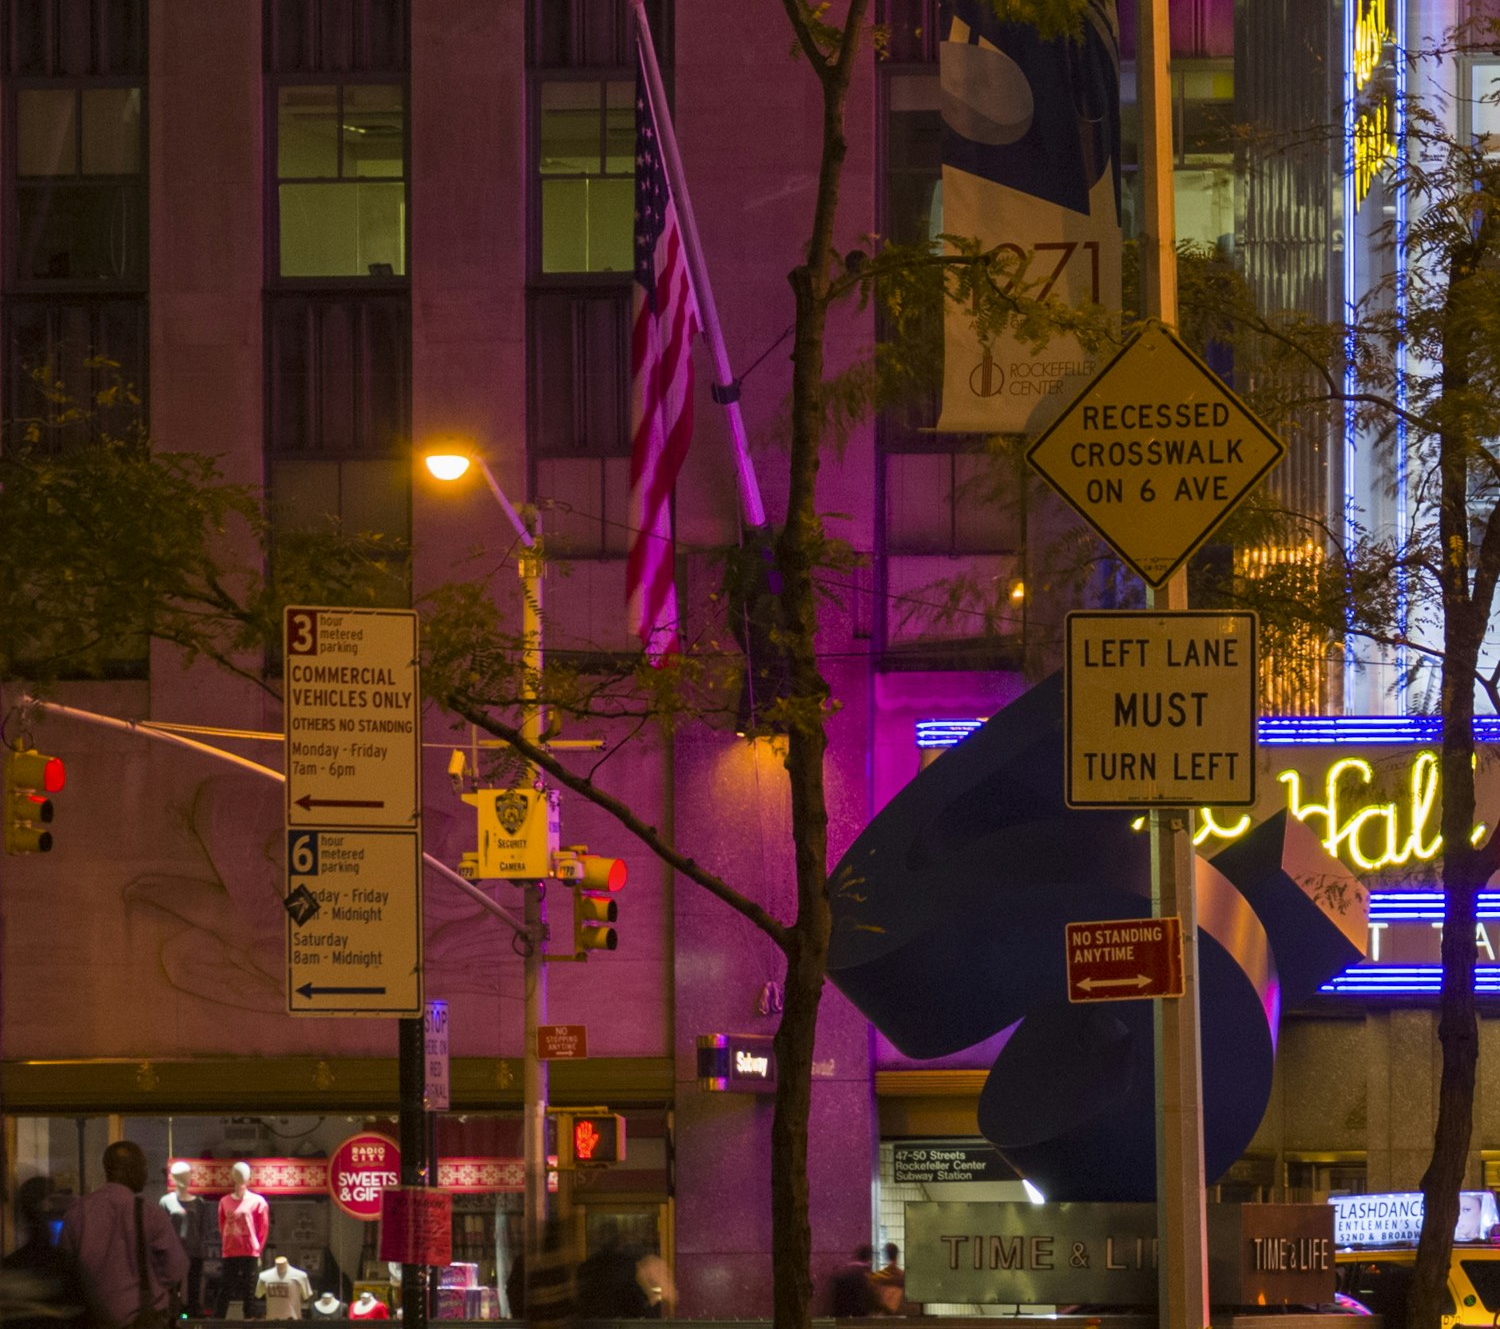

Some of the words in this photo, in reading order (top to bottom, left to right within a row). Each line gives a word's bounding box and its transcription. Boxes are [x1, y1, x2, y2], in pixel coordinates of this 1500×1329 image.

[1010, 361, 1096, 378] ROCKEFELLER
[1009, 381, 1063, 395] CENTER
[1083, 403, 1229, 430] RECESSED
[1071, 439, 1243, 467] CROSSWALK
[1087, 479, 1122, 503] ON
[1140, 479, 1155, 502] 6
[1174, 476, 1228, 501] AVE
[320, 615, 343, 627] hour
[292, 614, 312, 653] 3
[320, 628, 363, 641] metered
[320, 642, 358, 655] parking
[1085, 639, 1149, 667] LEFT
[1168, 639, 1238, 667] LANE
[292, 665, 396, 686] COMMERCIAL
[293, 689, 367, 708] VEHICLES
[372, 691, 412, 709] ONLY
[1115, 693, 1208, 726] MUST
[292, 717, 335, 732] OTHERS
[339, 718, 354, 732] NO
[358, 719, 413, 733] STANDING
[292, 742, 339, 759] Monday
[351, 744, 387, 760] Friday
[293, 761, 317, 776] 7am
[329, 763, 355, 778] 6pm
[1084, 753, 1155, 780] TURN
[1174, 753, 1239, 780] LEFT
[1278, 749, 1488, 869] Hal
[321, 835, 344, 846] hour
[292, 835, 313, 873] 6
[321, 849, 364, 860] metered
[321, 862, 360, 875] parking
[352, 889, 388, 905] Friday
[333, 907, 382, 925] Midnight
[294, 932, 348, 949] Saturday
[1072, 931, 1091, 946] NO
[1096, 927, 1162, 945] STANDING
[294, 952, 320, 964] 8am
[333, 951, 382, 968] Midnight
[1074, 946, 1135, 963] ANYTIME
[352, 1147, 385, 1155] RADIO
[896, 1151, 926, 1160] 47-50
[930, 1151, 966, 1160] Streets
[896, 1161, 949, 1171] Rockefeller
[953, 1161, 986, 1170] Center
[338, 1172, 398, 1187] SWEETS
[896, 1171, 934, 1181] Subway
[937, 1171, 972, 1180] Station
[340, 1188, 351, 1202] &
[353, 1187, 383, 1203] GIF
[1338, 1219, 1410, 1231] ENTLEMEN'S
[1339, 1232, 1365, 1242] 52ND
[1368, 1232, 1376, 1241] &
[1381, 1230, 1420, 1241] BROADW
[941, 1235, 1055, 1271] TIME
[1069, 1241, 1090, 1269] &
[1254, 1238, 1287, 1271] TIME
[1289, 1241, 1298, 1270] &
[1300, 1238, 1329, 1272] LIFE
